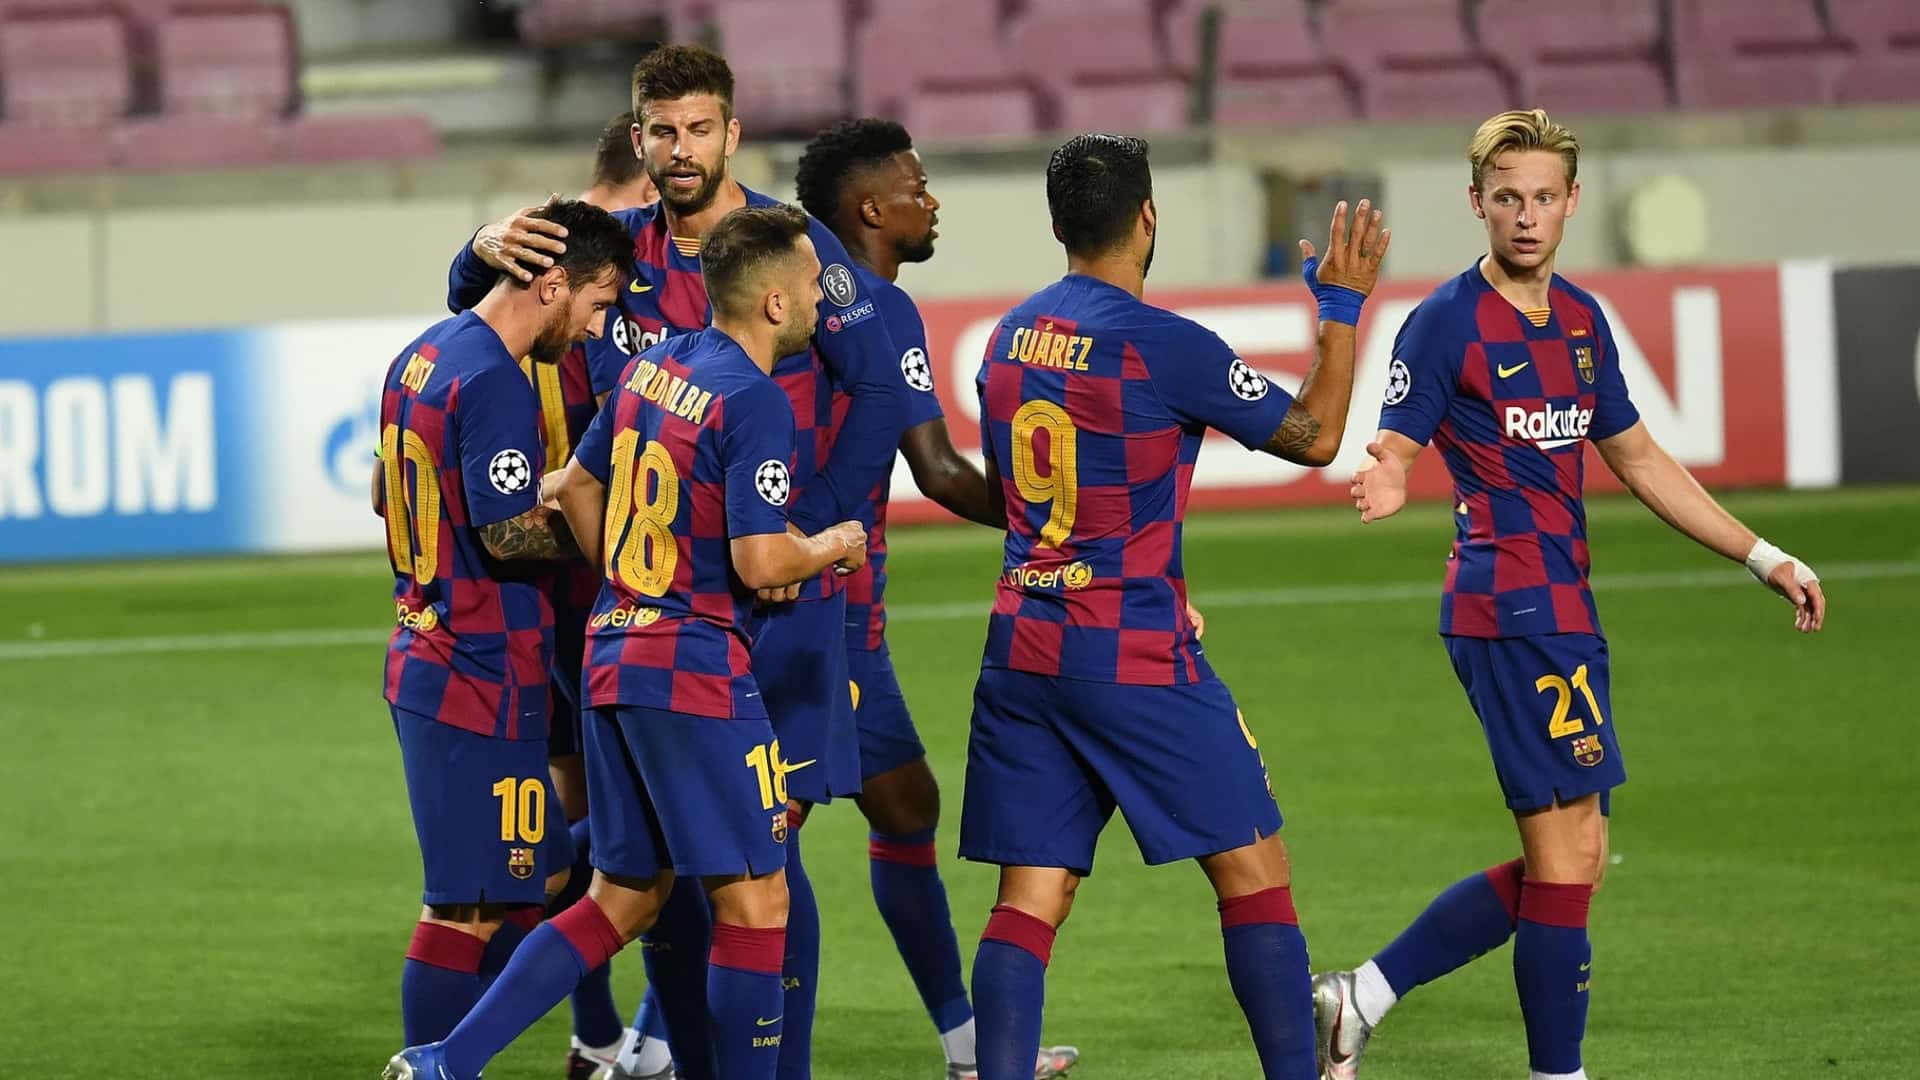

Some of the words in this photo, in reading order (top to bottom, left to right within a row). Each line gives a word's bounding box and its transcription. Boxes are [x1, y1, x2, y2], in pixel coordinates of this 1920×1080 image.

[841, 303, 874, 323] RESPECT
[1007, 321, 1094, 371] SUÁREZ
[1505, 403, 1594, 440] Rakute
[382, 422, 441, 586] 10
[1011, 399, 1078, 550] 9
[605, 426, 679, 598] 18
[1535, 663, 1604, 739] 21
[493, 777, 546, 844] 10
